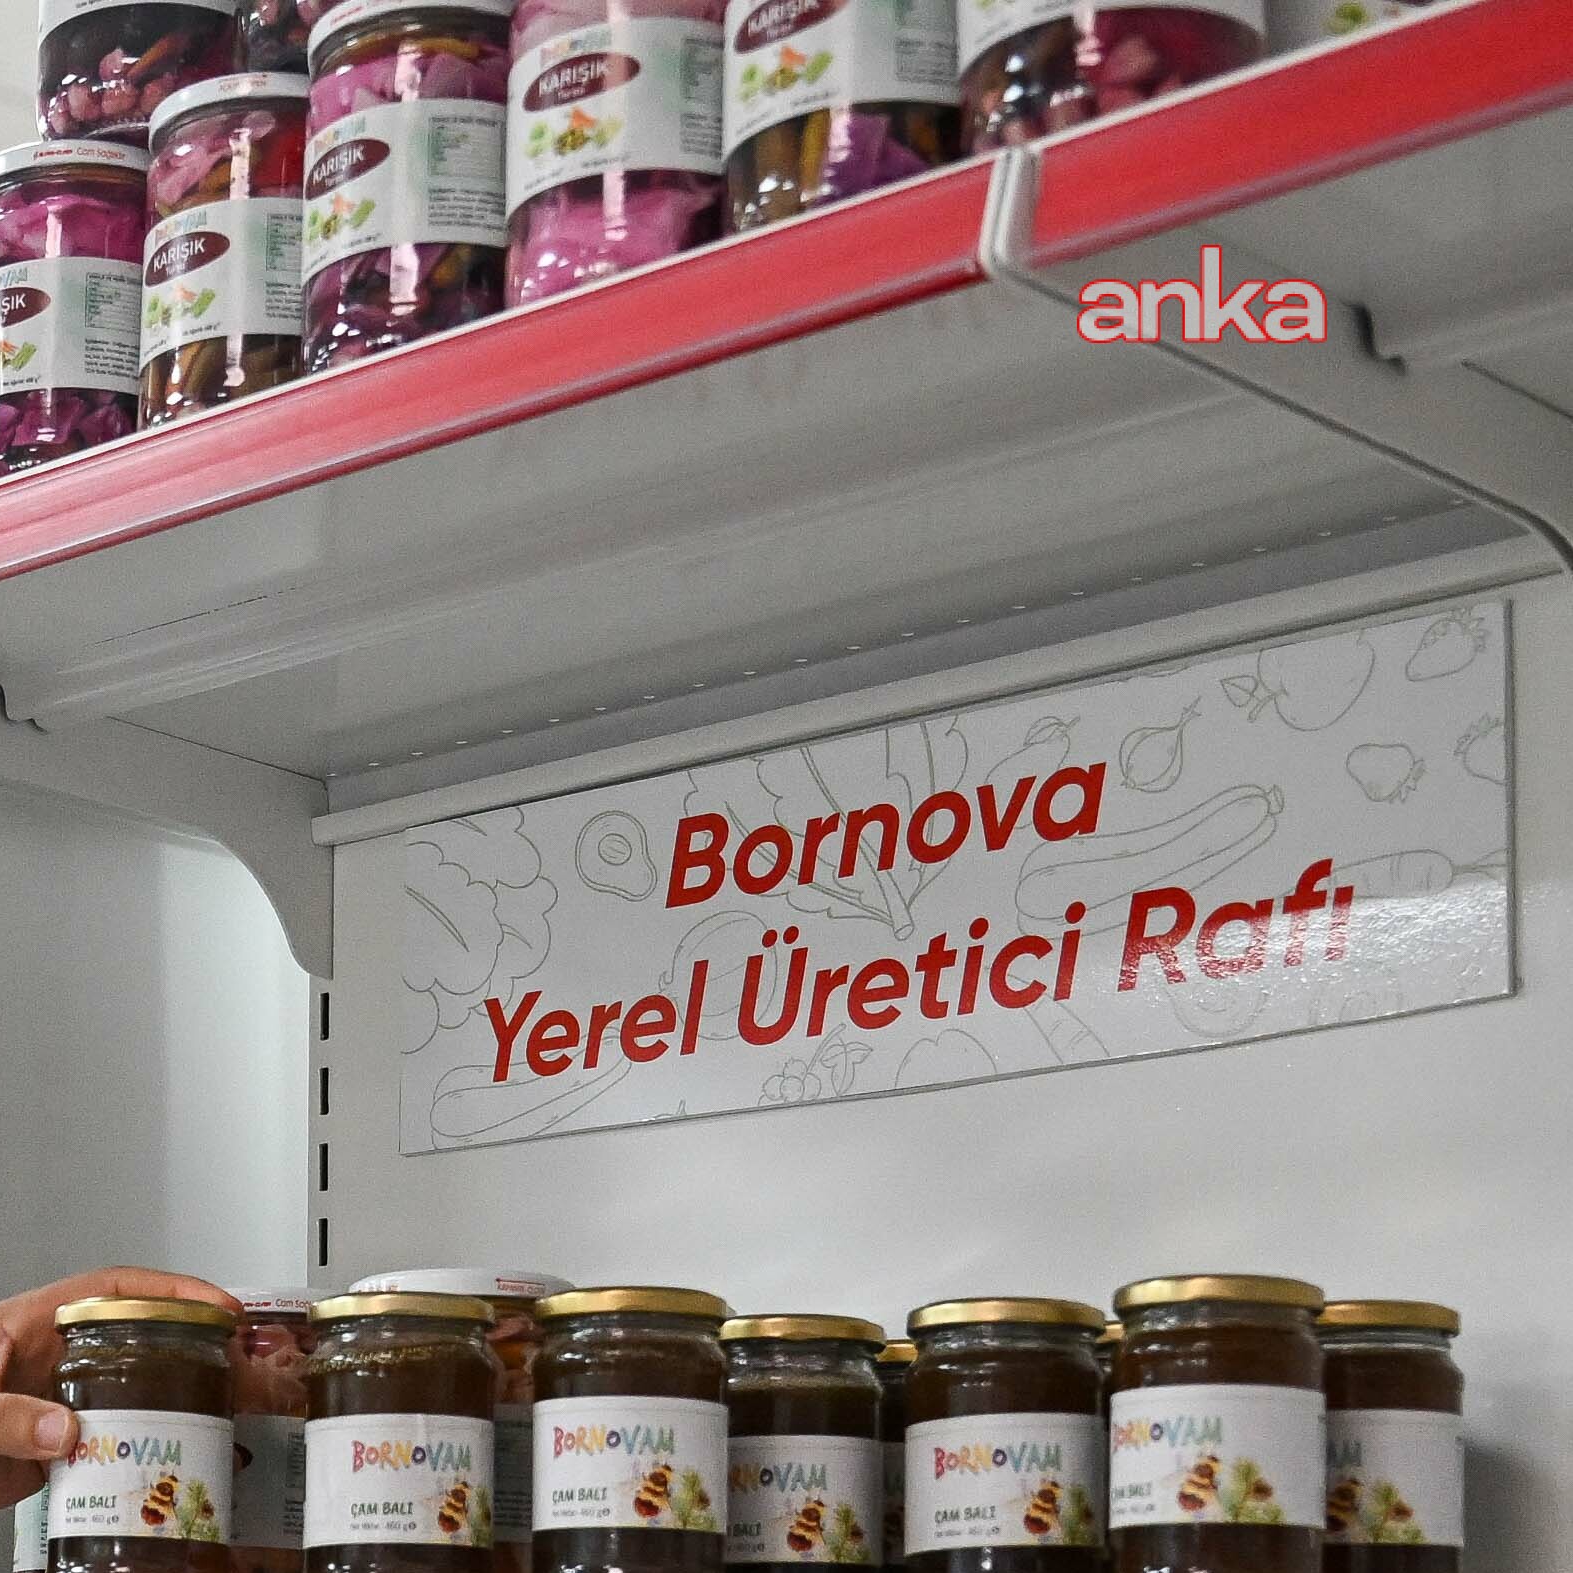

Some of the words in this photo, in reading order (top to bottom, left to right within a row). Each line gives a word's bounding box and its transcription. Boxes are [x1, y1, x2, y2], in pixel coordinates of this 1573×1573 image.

[539, 58, 610, 97] KARIŞIK
[312, 144, 365, 184] KARIŞIK
[153, 237, 206, 272] KARIŞIK
[667, 759, 1108, 910] Bornova
[484, 958, 708, 1084] Yerel
[737, 904, 1084, 1048] Üretici
[1117, 858, 1355, 992] Rafı
[351, 1439, 472, 1473] BORNOVAM
[554, 1423, 674, 1459] BORNOVAM
[730, 1462, 828, 1493] RNOVAM
[934, 1441, 1063, 1480] BORNOVAM
[66, 1497, 86, 1513] ÇAM
[89, 1494, 117, 1510] BALI
[382, 1501, 414, 1516] BALI
[578, 1487, 607, 1502] BALI
